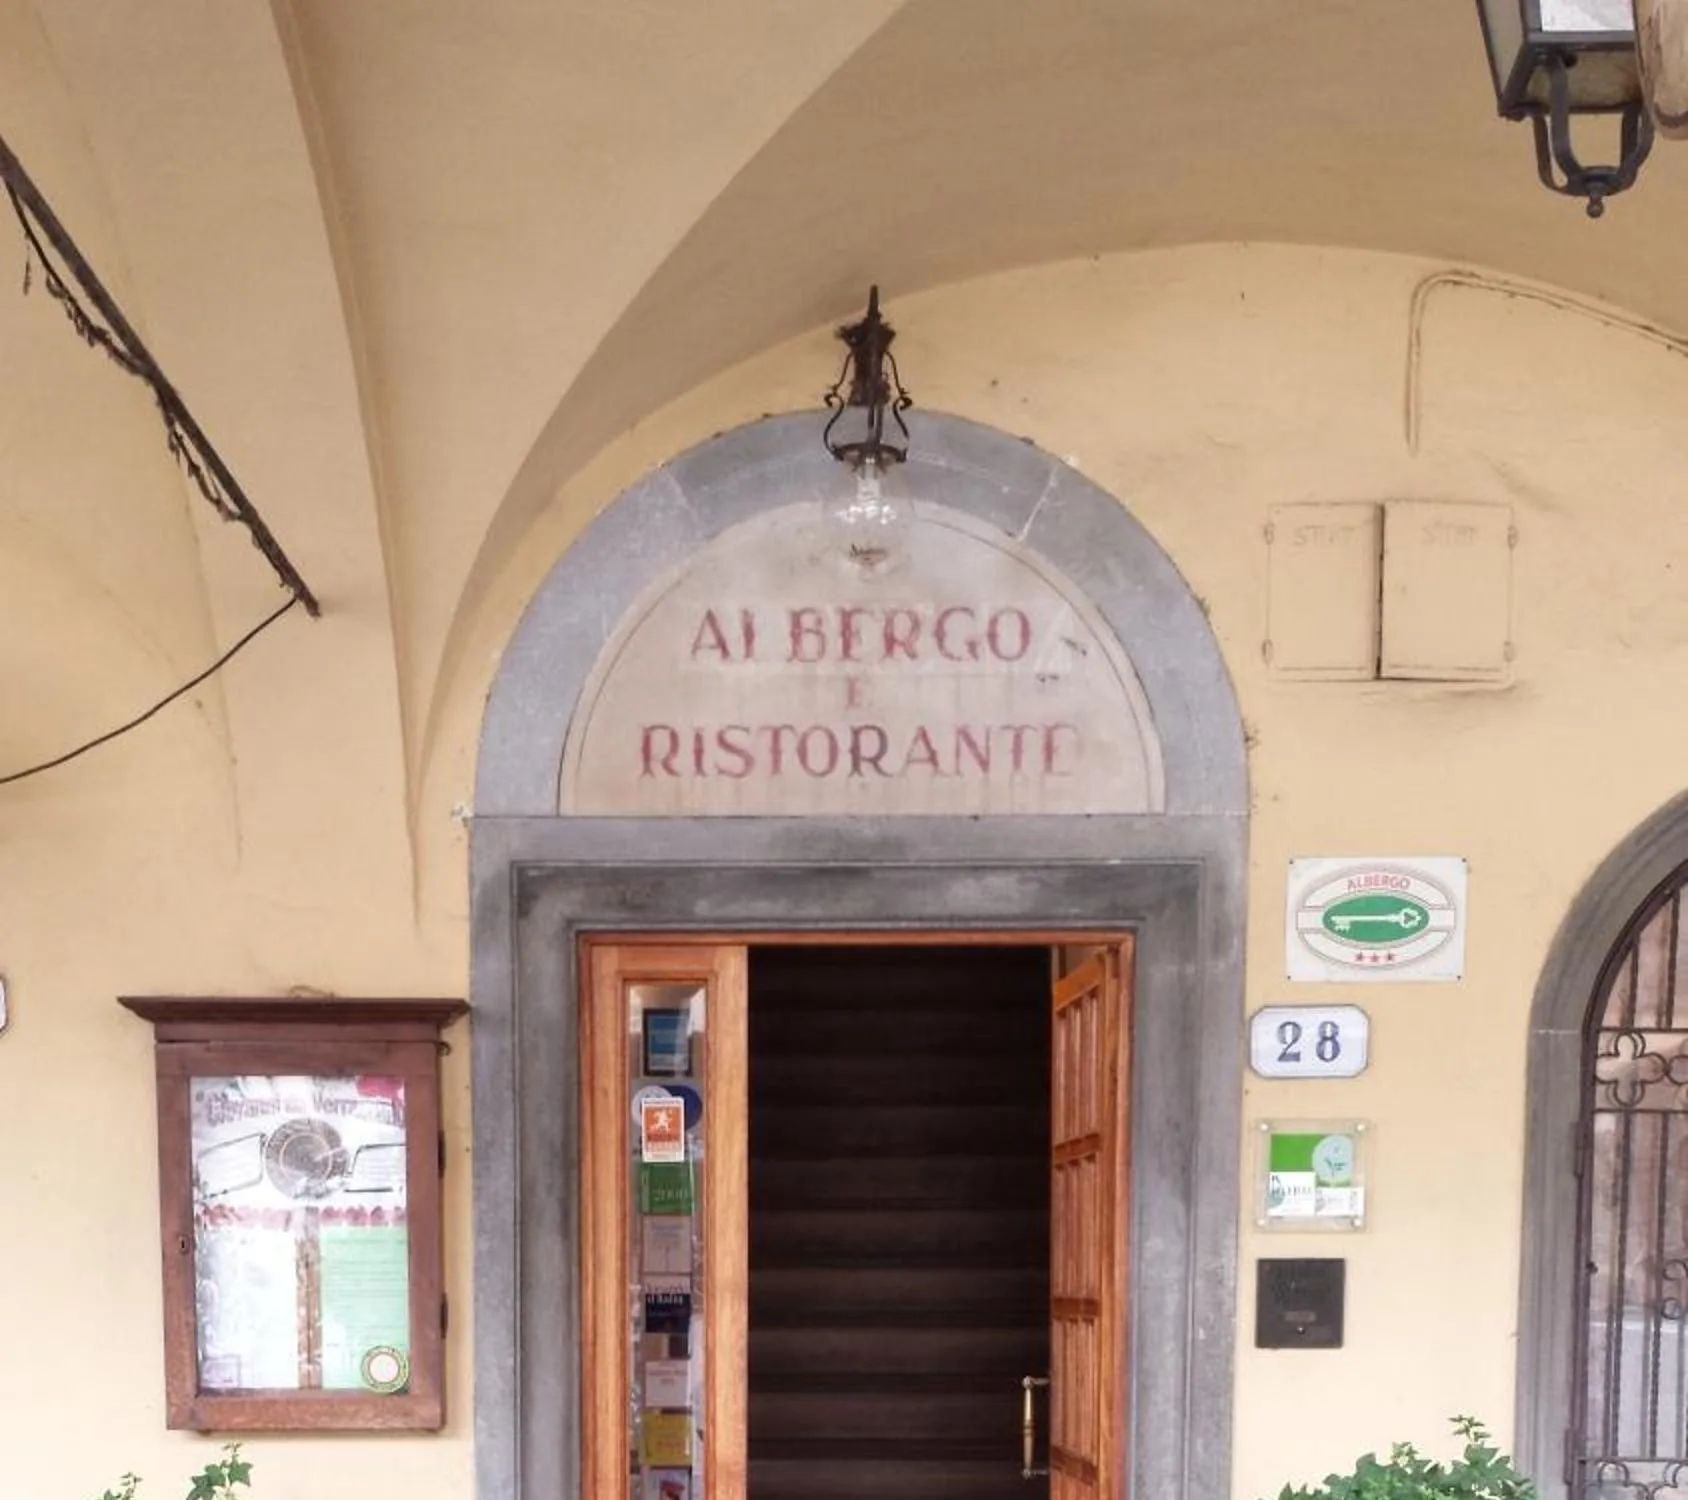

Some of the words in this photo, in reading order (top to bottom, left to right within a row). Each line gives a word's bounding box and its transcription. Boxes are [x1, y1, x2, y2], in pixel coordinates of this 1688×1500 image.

[690, 605, 1031, 662] ALBERGO
[639, 724, 1079, 779] RISTORANTE
[1346, 874, 1411, 891] ALBERGO
[1277, 1021, 1341, 1063] 28
